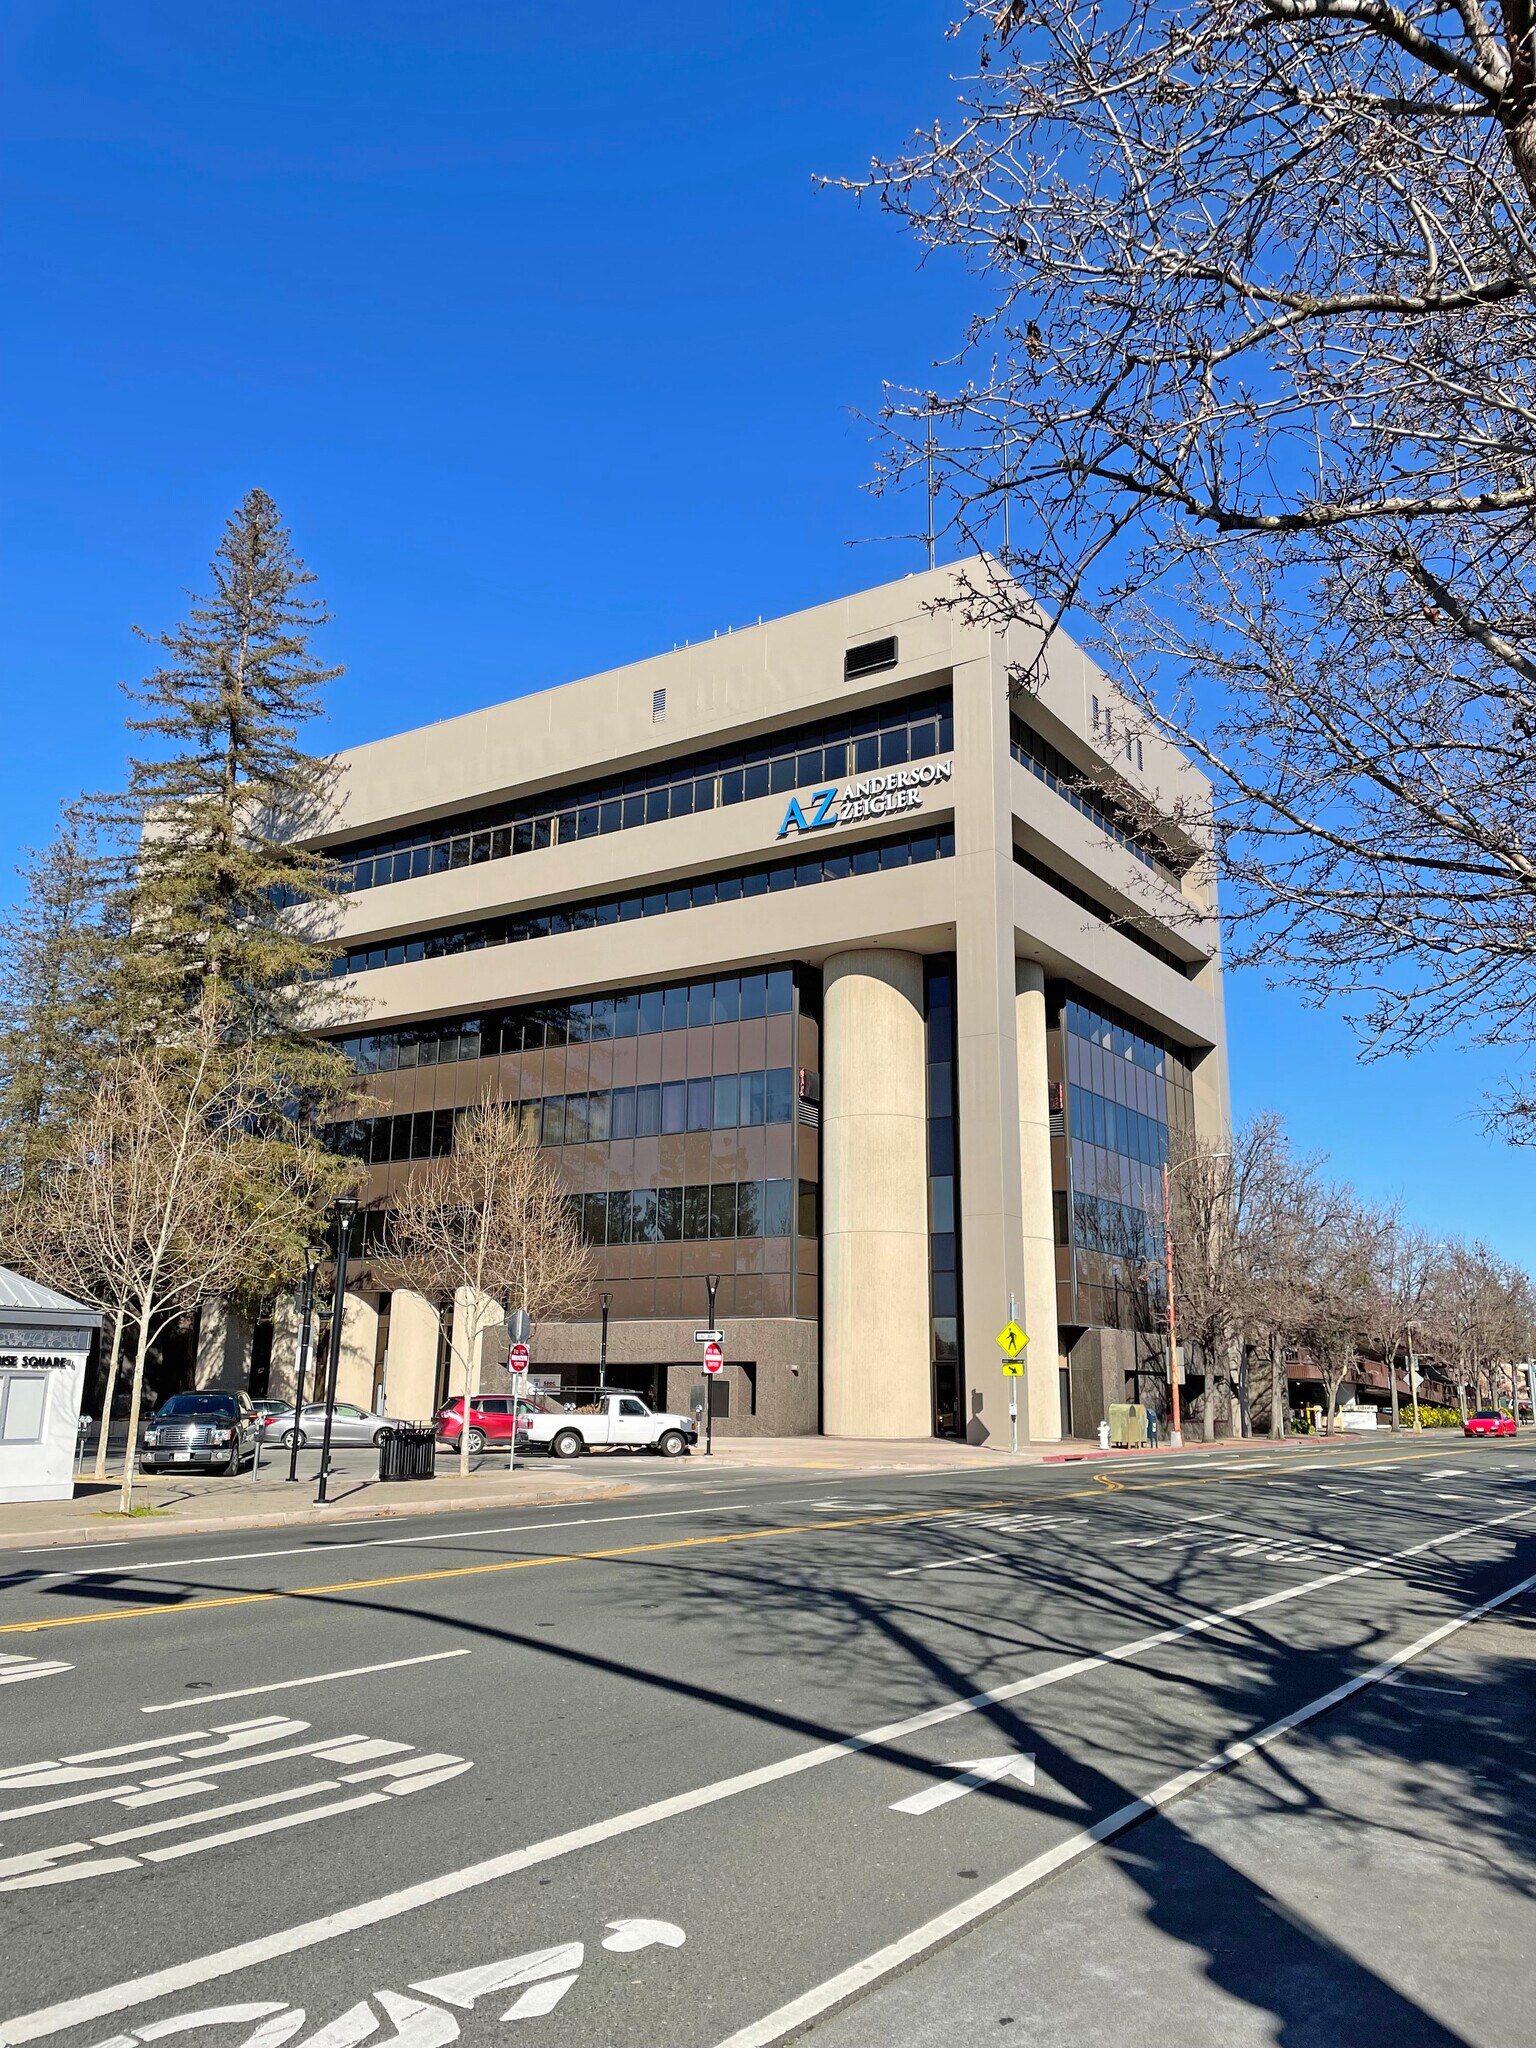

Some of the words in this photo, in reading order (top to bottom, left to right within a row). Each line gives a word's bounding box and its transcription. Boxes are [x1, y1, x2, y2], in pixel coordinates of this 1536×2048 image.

[842, 760, 952, 801] ANDERSON
[777, 787, 838, 835] AZ
[840, 788, 922, 820] ZEIGLER
[21, 1356, 67, 1368] SQUARE
